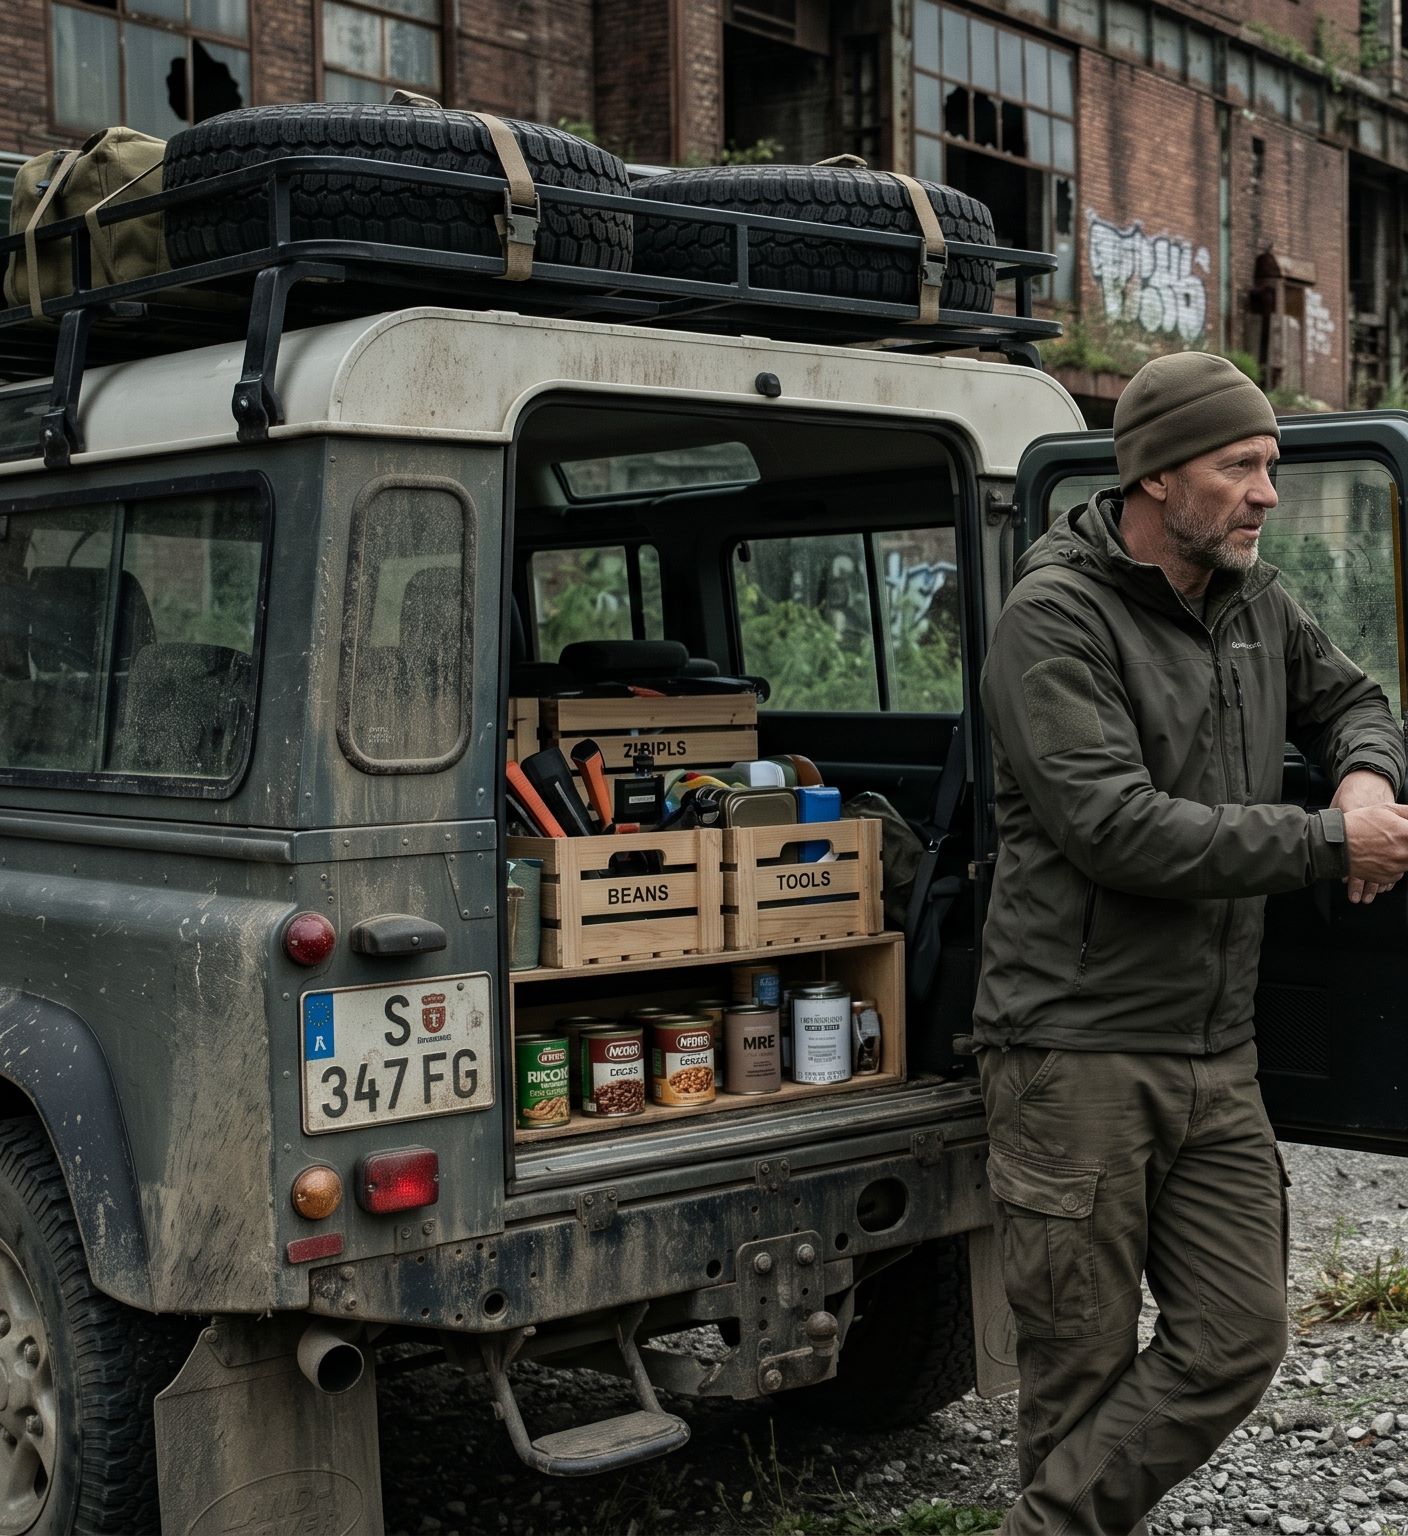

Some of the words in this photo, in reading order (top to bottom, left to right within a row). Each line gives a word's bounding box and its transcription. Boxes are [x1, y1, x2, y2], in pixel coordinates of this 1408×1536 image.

[776, 870, 831, 891] TOOLS
[607, 884, 669, 905] BEANS
[384, 994, 411, 1047] S
[743, 1034, 775, 1051] MRE
[320, 1056, 409, 1119] 347
[422, 1048, 478, 1105] FG
